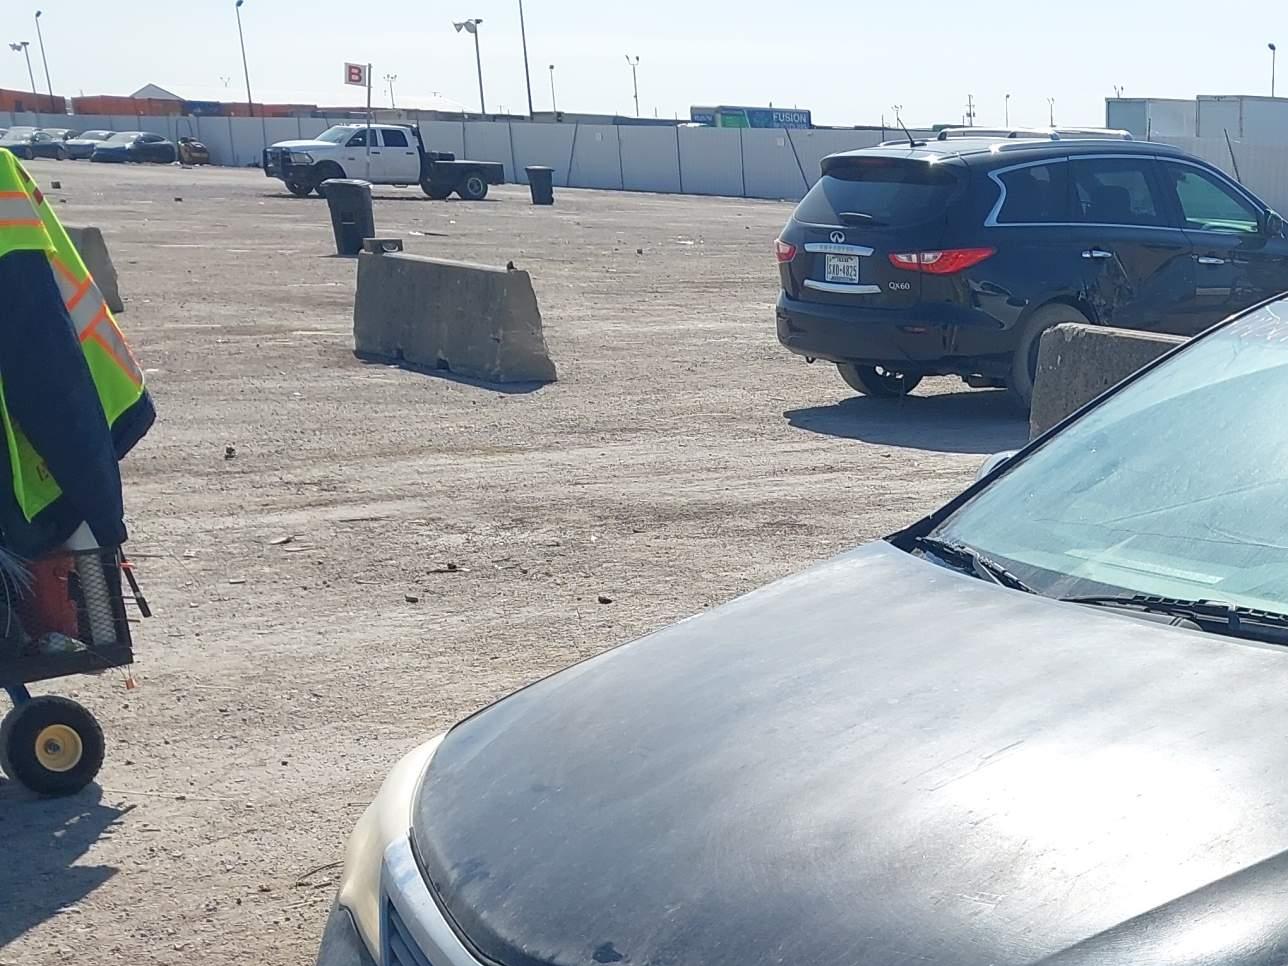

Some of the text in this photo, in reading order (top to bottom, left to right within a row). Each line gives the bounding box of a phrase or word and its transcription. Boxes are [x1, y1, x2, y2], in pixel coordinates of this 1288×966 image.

[348, 65, 361, 82] B
[772, 111, 808, 123] FUSION
[888, 282, 911, 290] QX60
